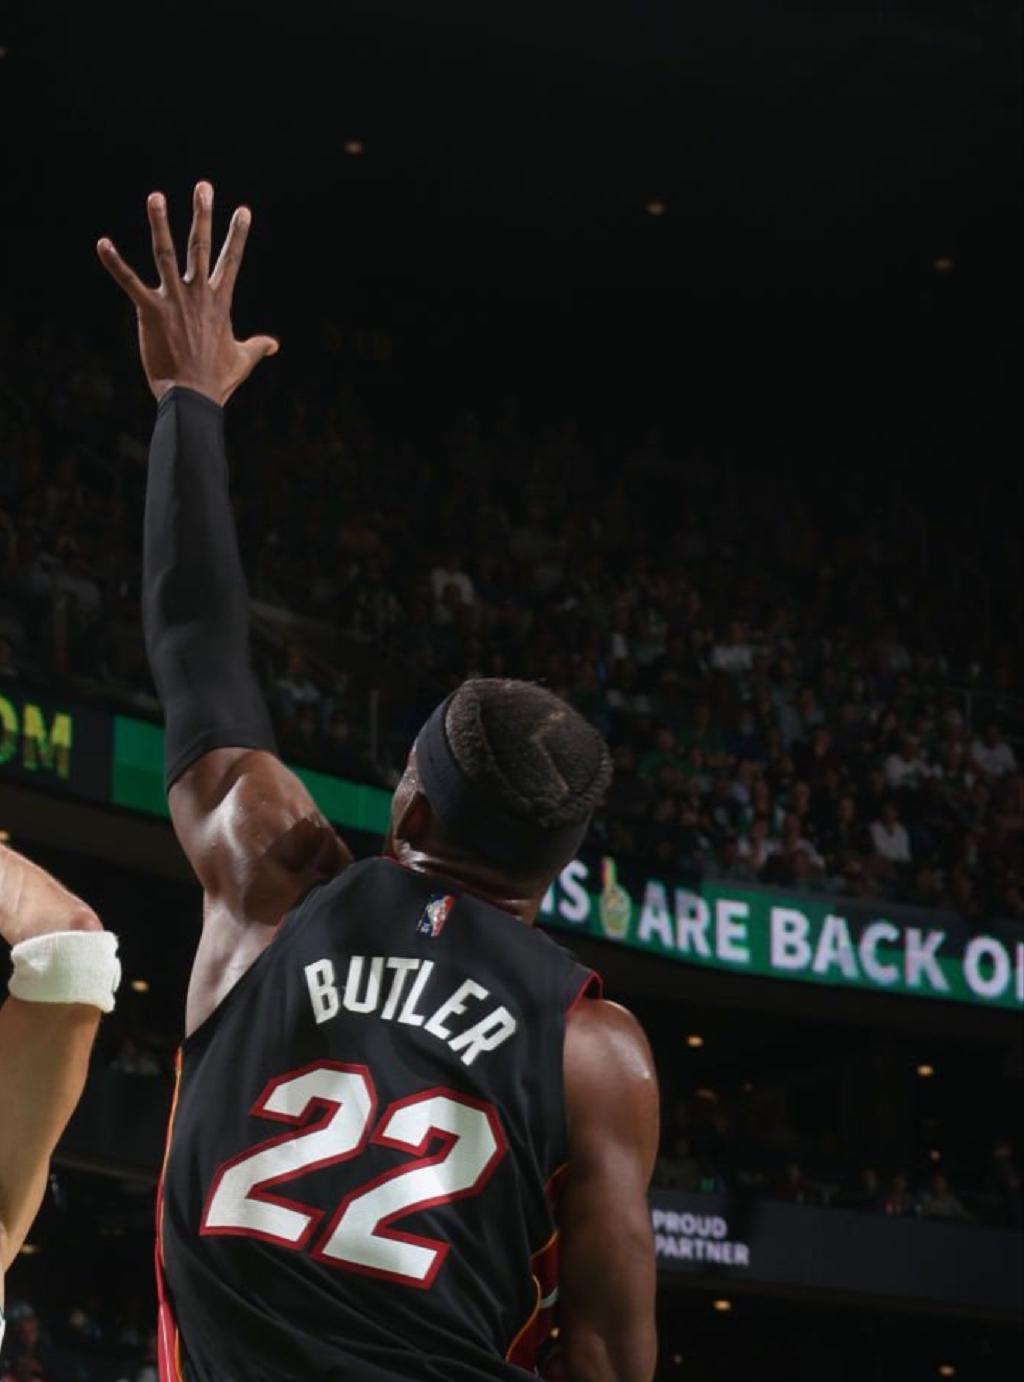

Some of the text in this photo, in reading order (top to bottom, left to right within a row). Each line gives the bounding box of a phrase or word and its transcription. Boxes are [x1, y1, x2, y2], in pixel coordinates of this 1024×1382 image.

[638, 879, 750, 963] ARE
[770, 905, 949, 982] BACK
[304, 955, 517, 1066] BUTLER
[198, 1058, 511, 1291] 22
[652, 1209, 728, 1239] PROUD
[654, 1233, 750, 1267] PARTNER
